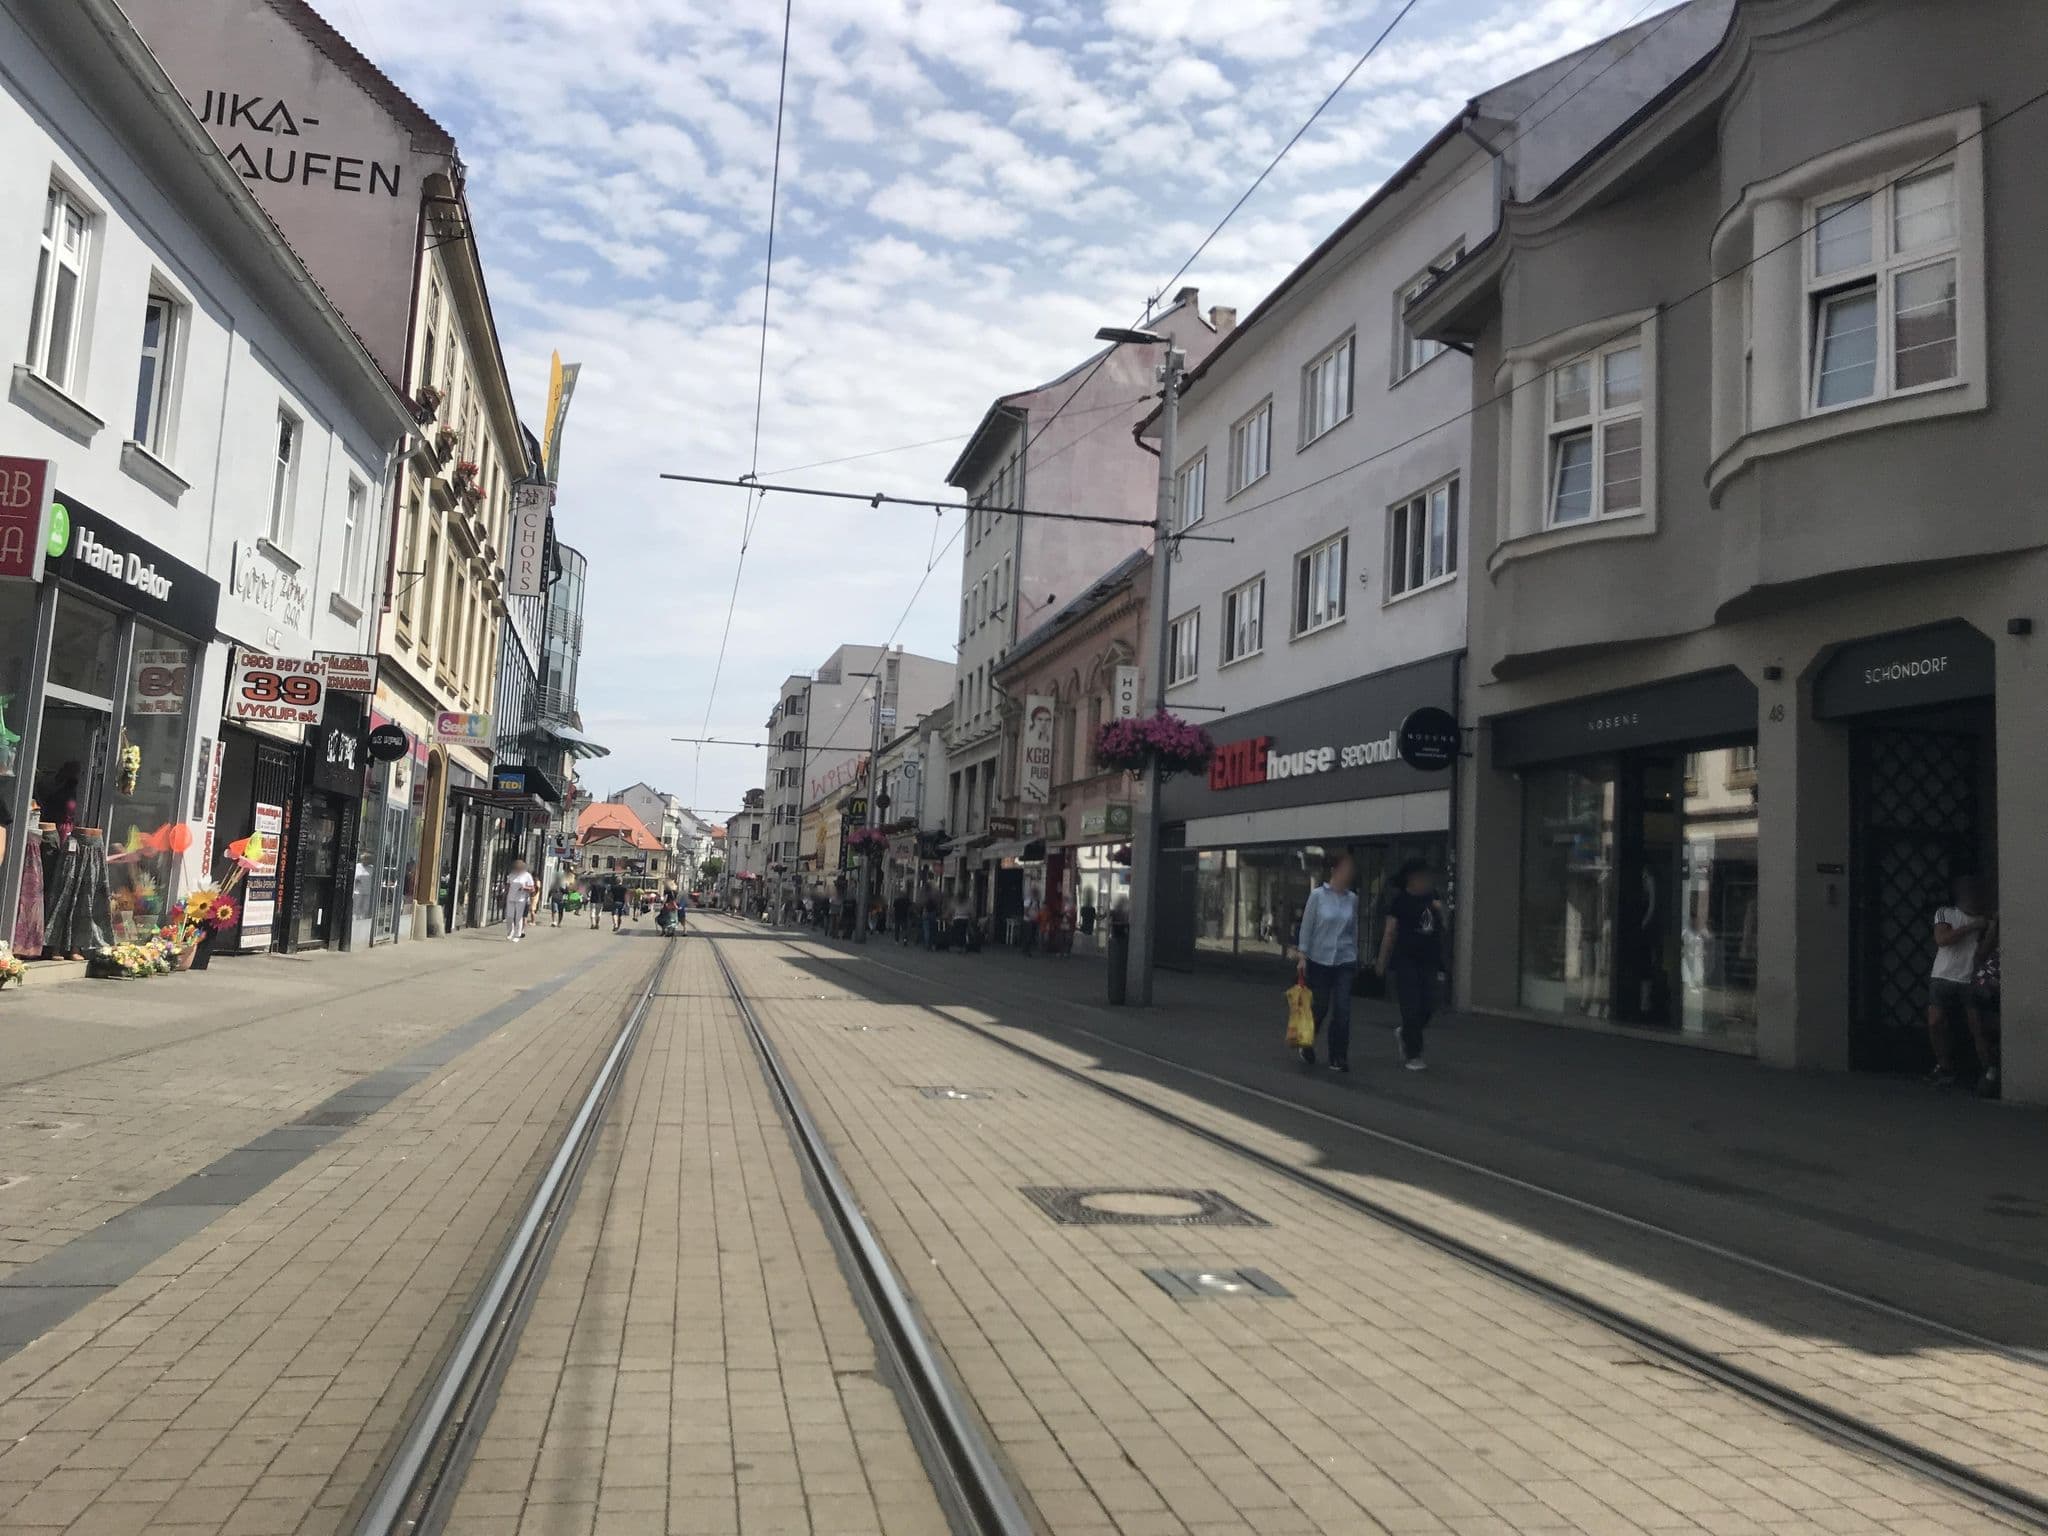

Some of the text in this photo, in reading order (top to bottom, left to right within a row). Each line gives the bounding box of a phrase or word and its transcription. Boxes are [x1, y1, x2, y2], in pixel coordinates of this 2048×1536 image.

[186, 90, 319, 136] JIKA-
[227, 143, 400, 197] AUFEN
[519, 497, 538, 591] CHORS
[75, 526, 173, 602] Hana Dekor
[241, 653, 326, 676] 0903 287 001
[1864, 656, 1948, 684] SCHÖNDORF
[241, 670, 322, 707] 39
[1768, 703, 1785, 722] 48
[1026, 746, 1050, 765] KGB
[1340, 730, 1401, 769] second
[1030, 766, 1049, 780] PUB
